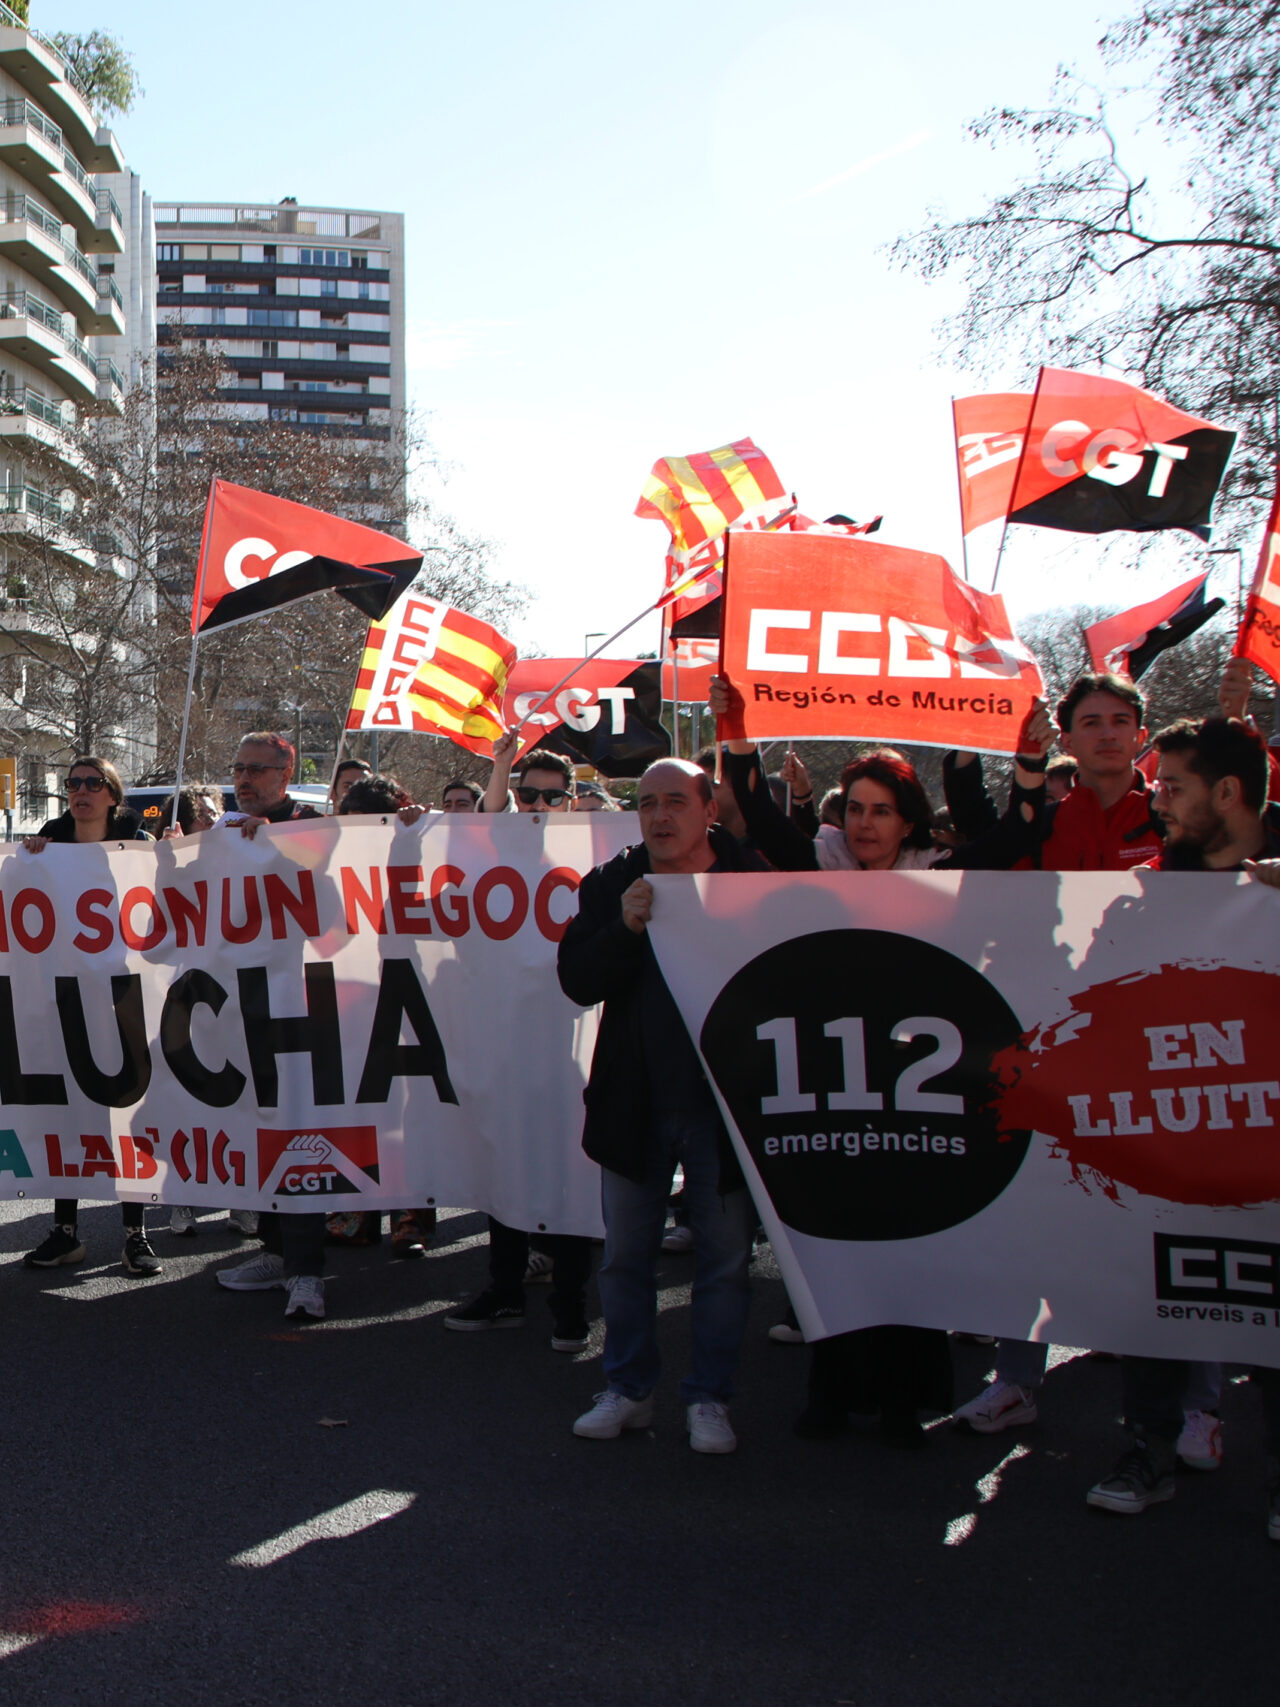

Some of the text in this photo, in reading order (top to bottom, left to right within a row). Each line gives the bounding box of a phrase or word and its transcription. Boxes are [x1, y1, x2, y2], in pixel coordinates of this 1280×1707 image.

[1041, 420, 1189, 498] CGT
[514, 687, 636, 735] CGT
[753, 683, 1014, 716] Región de Murcia
[73, 880, 208, 954] SON
[220, 869, 320, 944] UN
[756, 1016, 965, 1115] 112
[1144, 1019, 1246, 1072] EN
[1067, 1081, 1280, 1138] LLUIT
[764, 1123, 967, 1157] emergències
[285, 1171, 339, 1192] CGT
[1156, 1304, 1245, 1324] serveis
[1252, 1312, 1267, 1327] a
